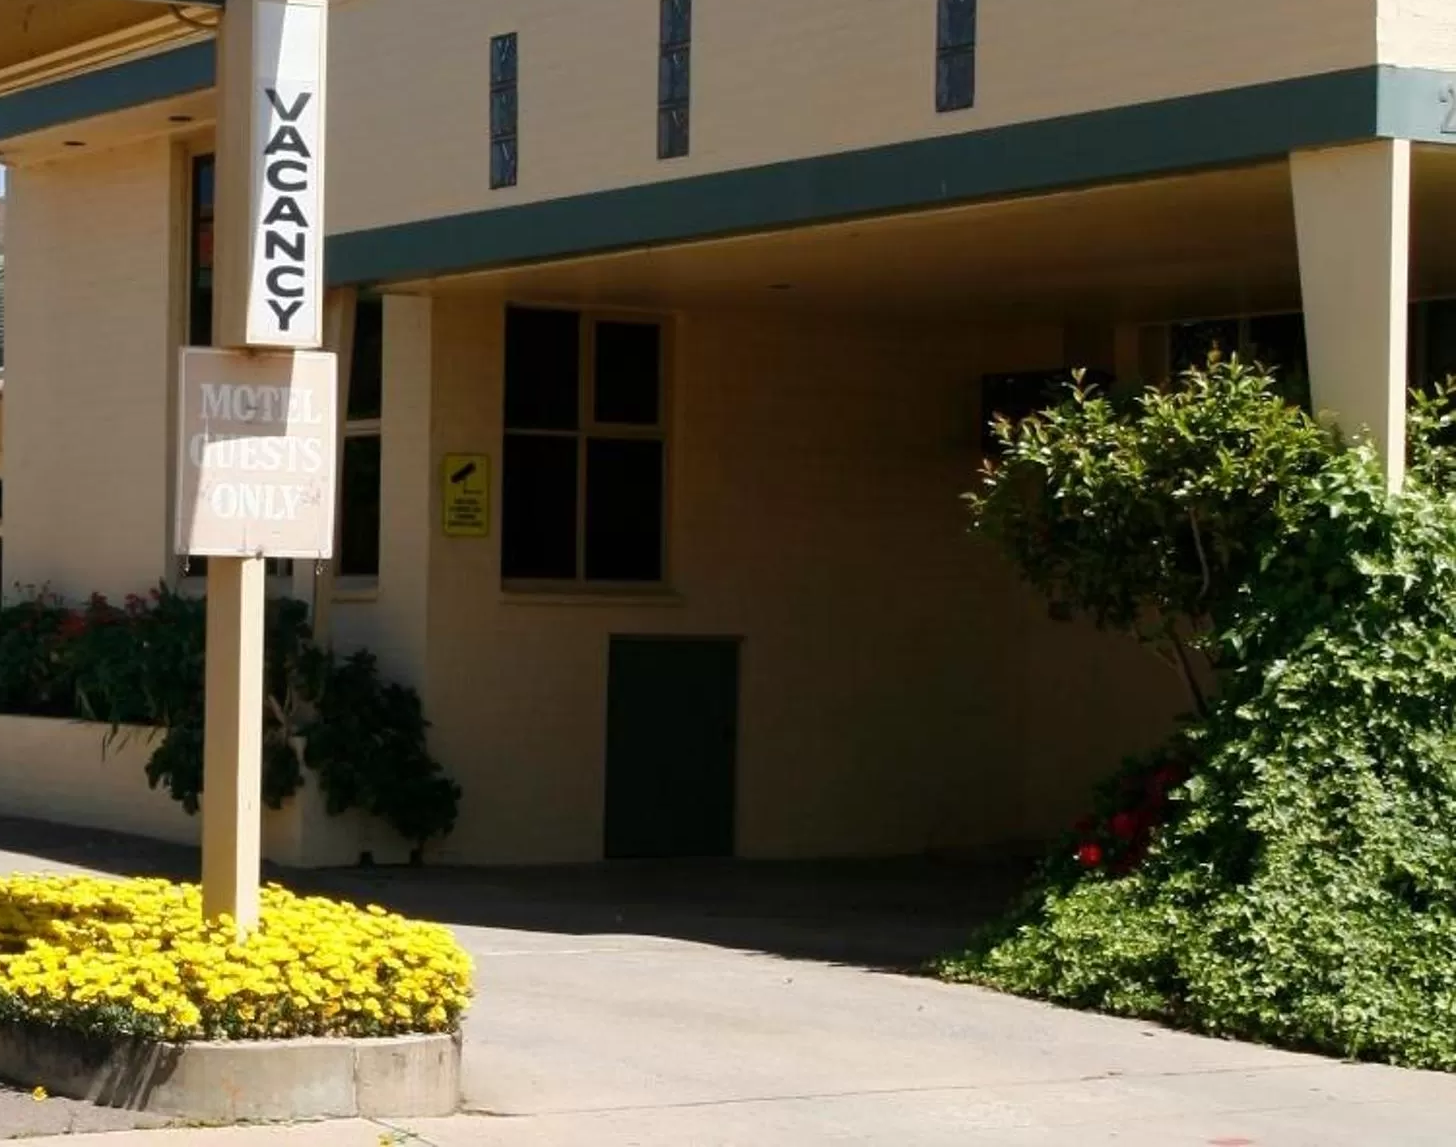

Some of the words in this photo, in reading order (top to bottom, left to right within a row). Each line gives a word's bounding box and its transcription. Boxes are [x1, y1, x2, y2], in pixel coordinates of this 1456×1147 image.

[262, 88, 312, 331] VACANCY
[200, 383, 322, 424] MOTEL
[190, 433, 322, 473] GUESTS
[211, 483, 302, 520] ONLY
